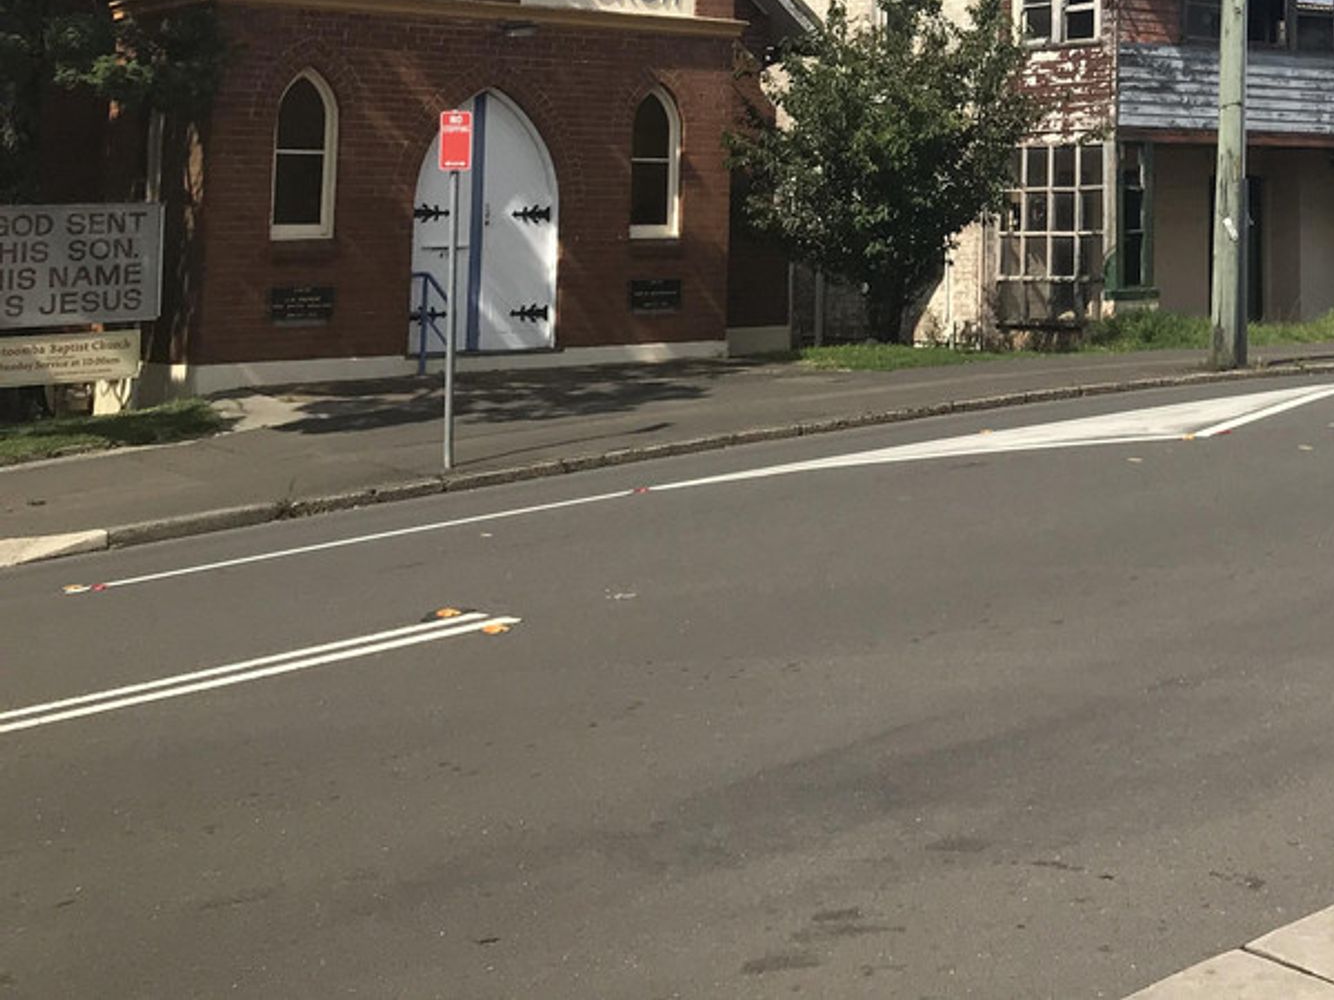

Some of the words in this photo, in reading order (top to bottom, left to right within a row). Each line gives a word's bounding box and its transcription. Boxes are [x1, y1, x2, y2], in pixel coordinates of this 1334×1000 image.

[66, 212, 148, 235] SENT
[0, 241, 49, 263] HIS
[68, 238, 139, 261] SON.
[0, 267, 37, 291] IS
[49, 262, 142, 288] NAME
[39, 288, 142, 315] JESUS
[49, 341, 90, 355] Baptist
[91, 338, 131, 351] Church
[35, 359, 69, 369] Service
